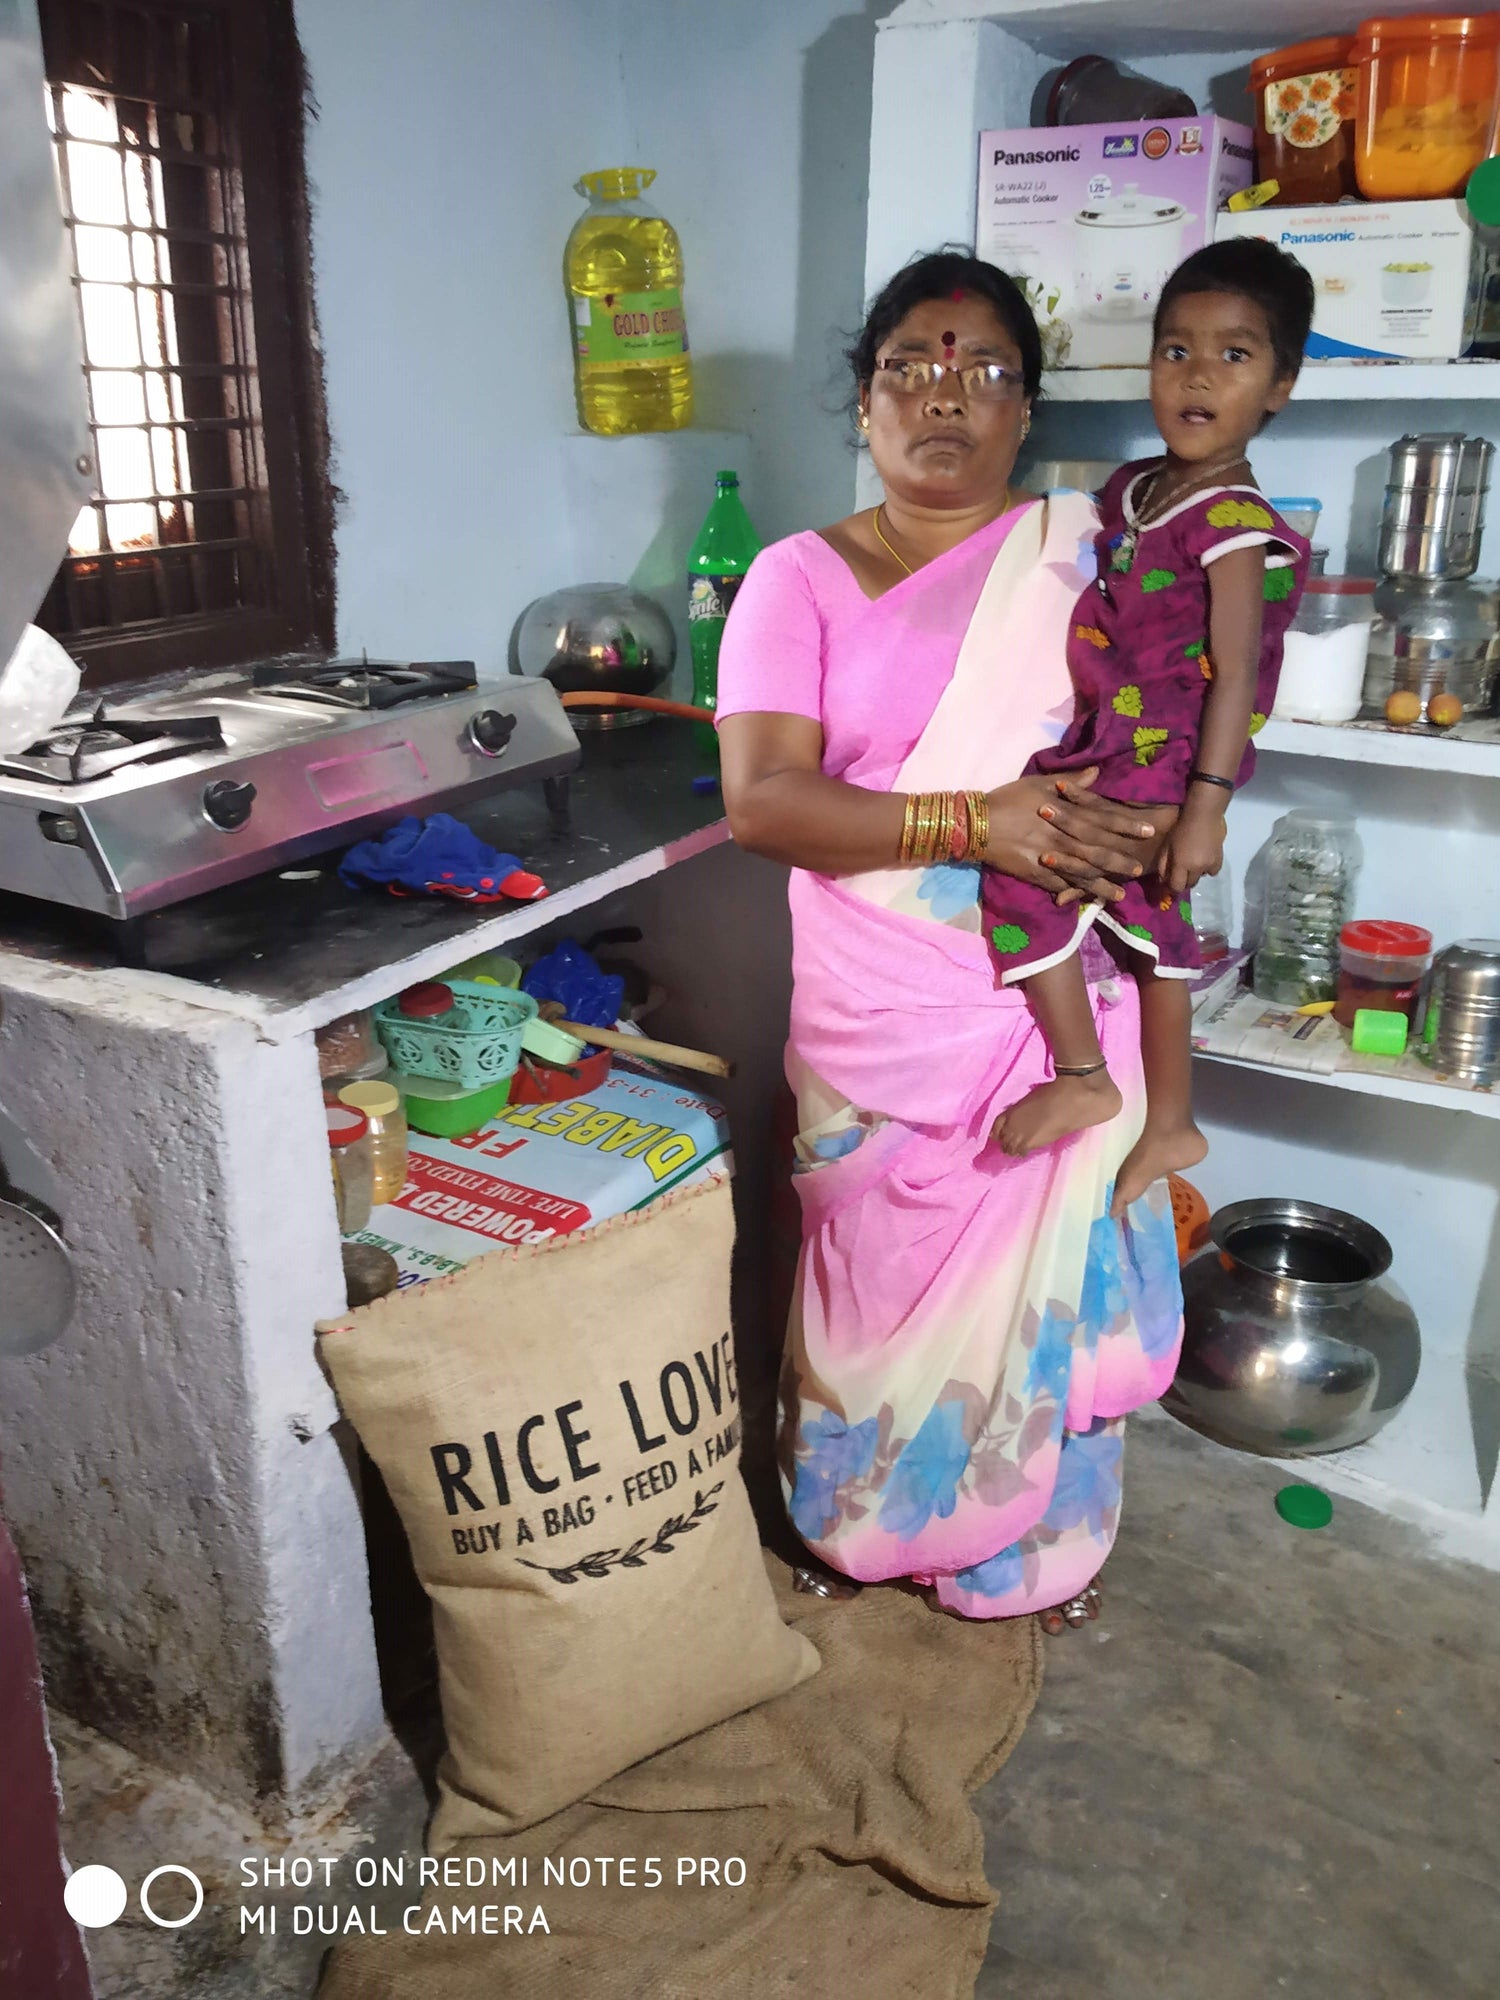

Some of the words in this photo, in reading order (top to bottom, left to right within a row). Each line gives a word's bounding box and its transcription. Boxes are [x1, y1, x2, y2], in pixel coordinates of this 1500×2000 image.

[994, 145, 1080, 166] Panasonic
[1281, 230, 1355, 244] Panasonic
[613, 312, 650, 336] GOLD
[675, 1096, 726, 1121] Date
[427, 1165, 488, 1191] FIXED
[481, 1182, 533, 1206] TIME
[409, 1190, 557, 1244] POWERED
[529, 1197, 580, 1219] LIFE
[430, 1399, 601, 1516] RICE
[619, 1331, 737, 1454] LOVE
[451, 1522, 503, 1555] BUY
[517, 1517, 535, 1546] A
[543, 1495, 596, 1538] BAG
[622, 1460, 678, 1507] FEED
[688, 1448, 703, 1479] A
